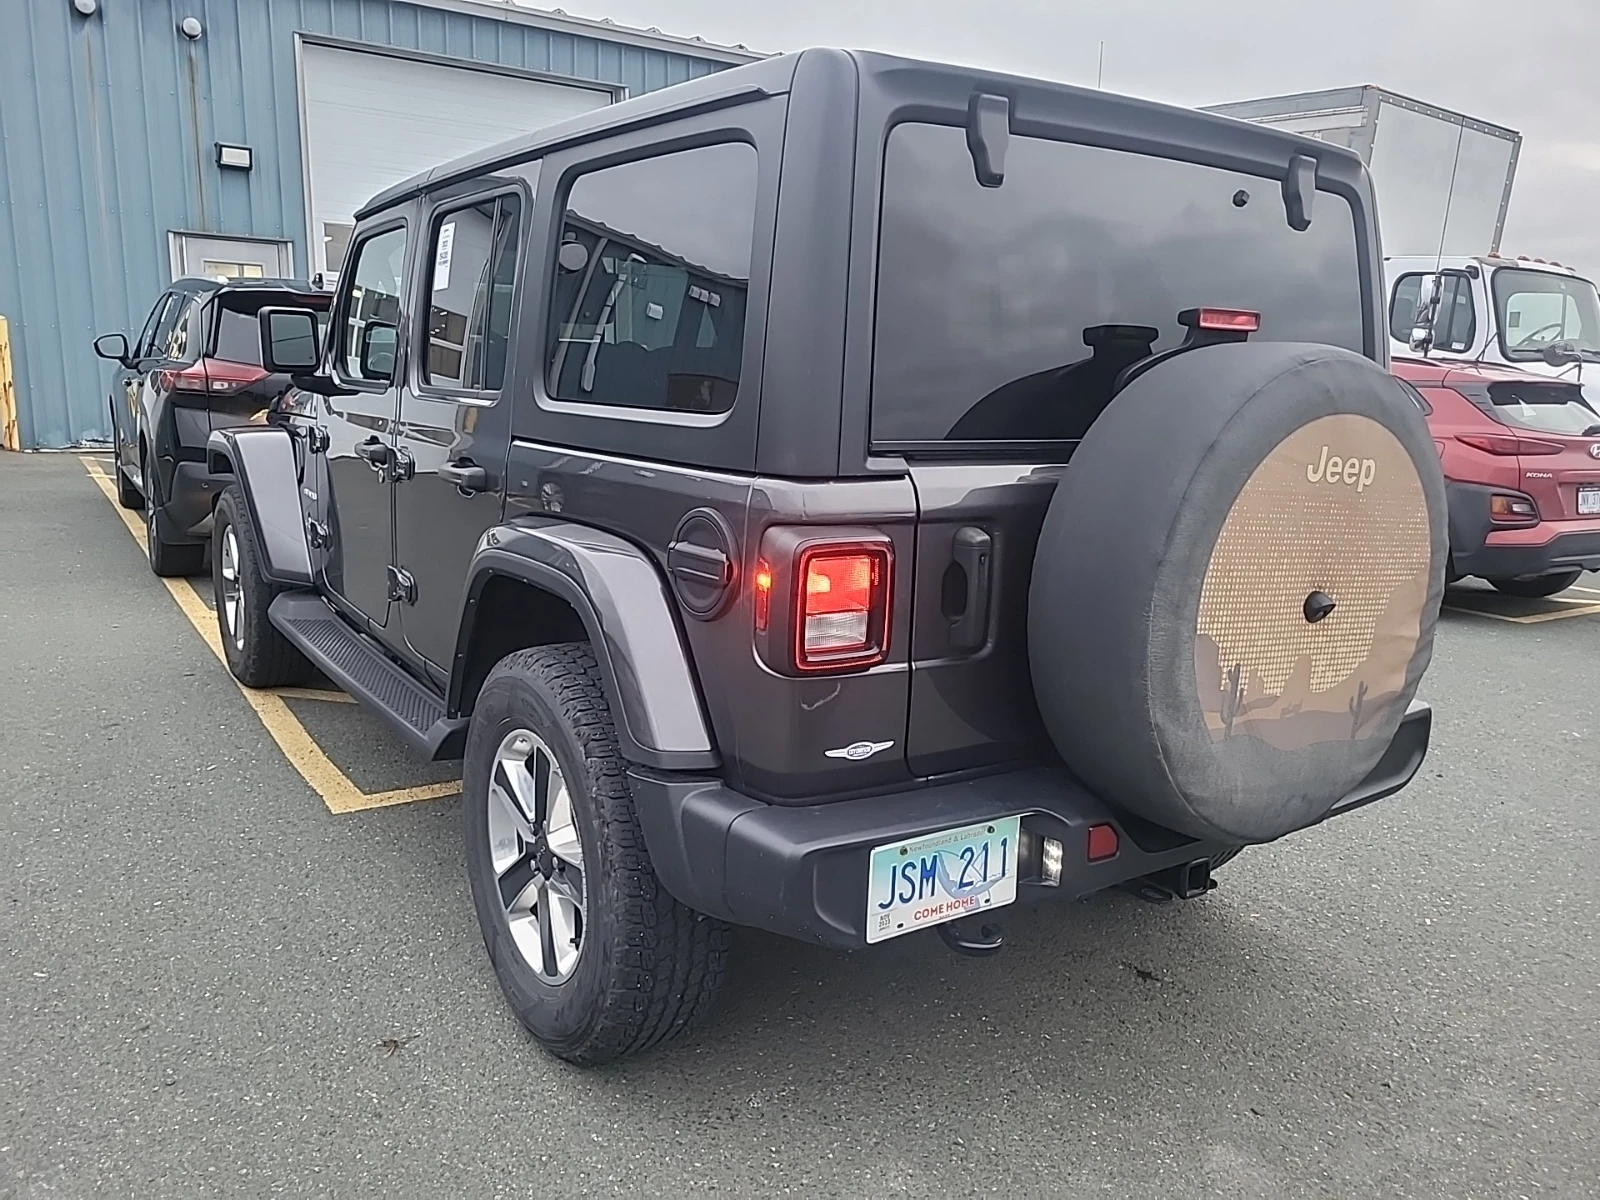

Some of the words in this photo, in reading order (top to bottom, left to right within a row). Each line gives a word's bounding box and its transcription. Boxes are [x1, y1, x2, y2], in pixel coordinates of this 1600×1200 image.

[1306, 445, 1376, 493] Jeep
[909, 836, 952, 853] Newfoundland
[960, 827, 987, 841] Labrador
[877, 854, 938, 910] JSM
[958, 836, 1008, 890] 211
[914, 903, 944, 921] COME
[946, 895, 976, 912] HOME
